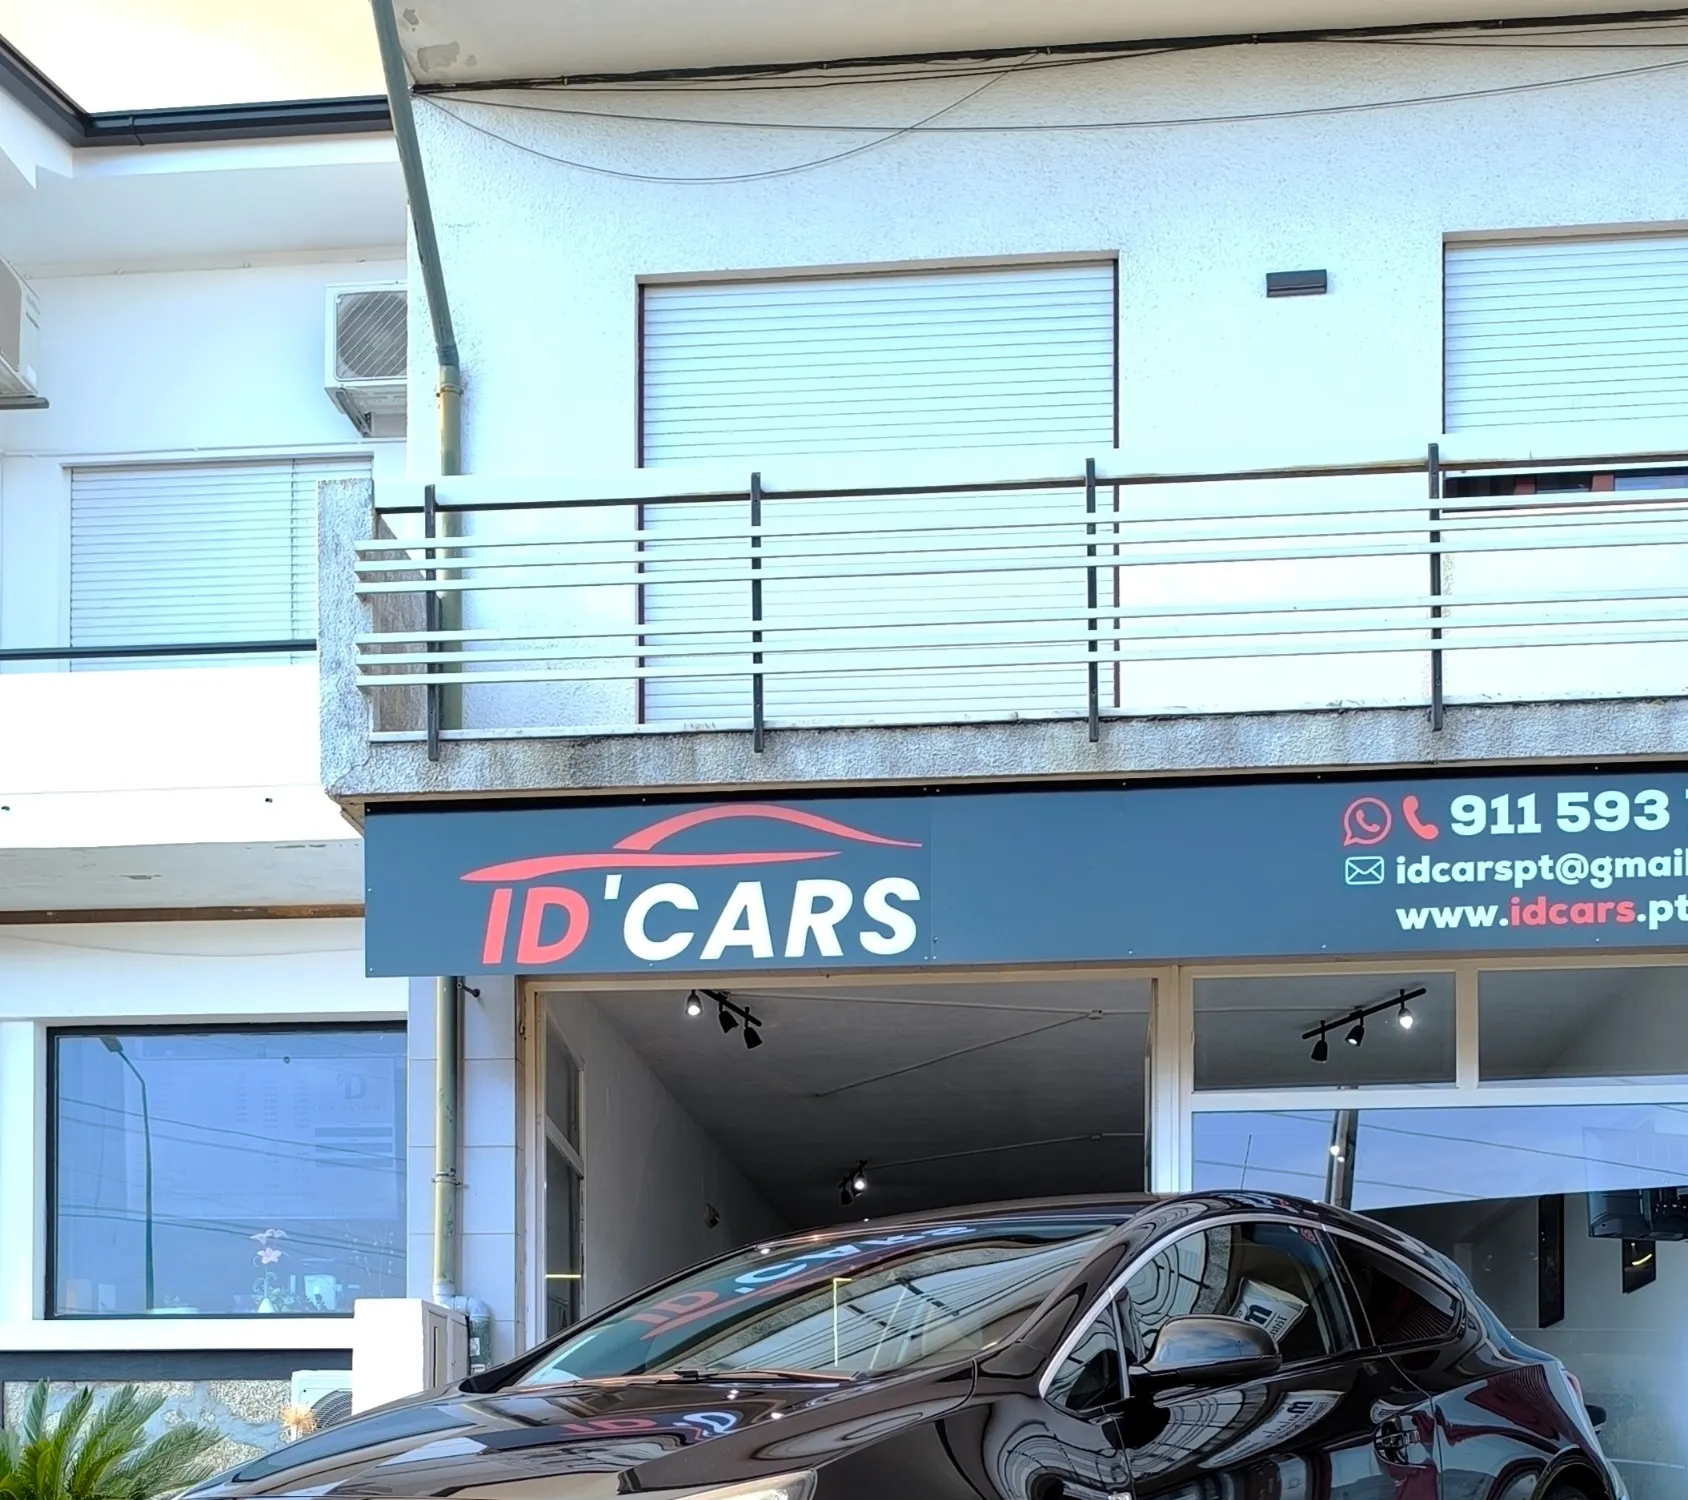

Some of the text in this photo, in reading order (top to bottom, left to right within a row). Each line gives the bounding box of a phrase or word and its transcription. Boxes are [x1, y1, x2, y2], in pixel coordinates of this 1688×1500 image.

[1450, 792, 1542, 836] 911
[1556, 789, 1670, 833] 593
[1395, 893, 1688, 931] www.idcars.pt
